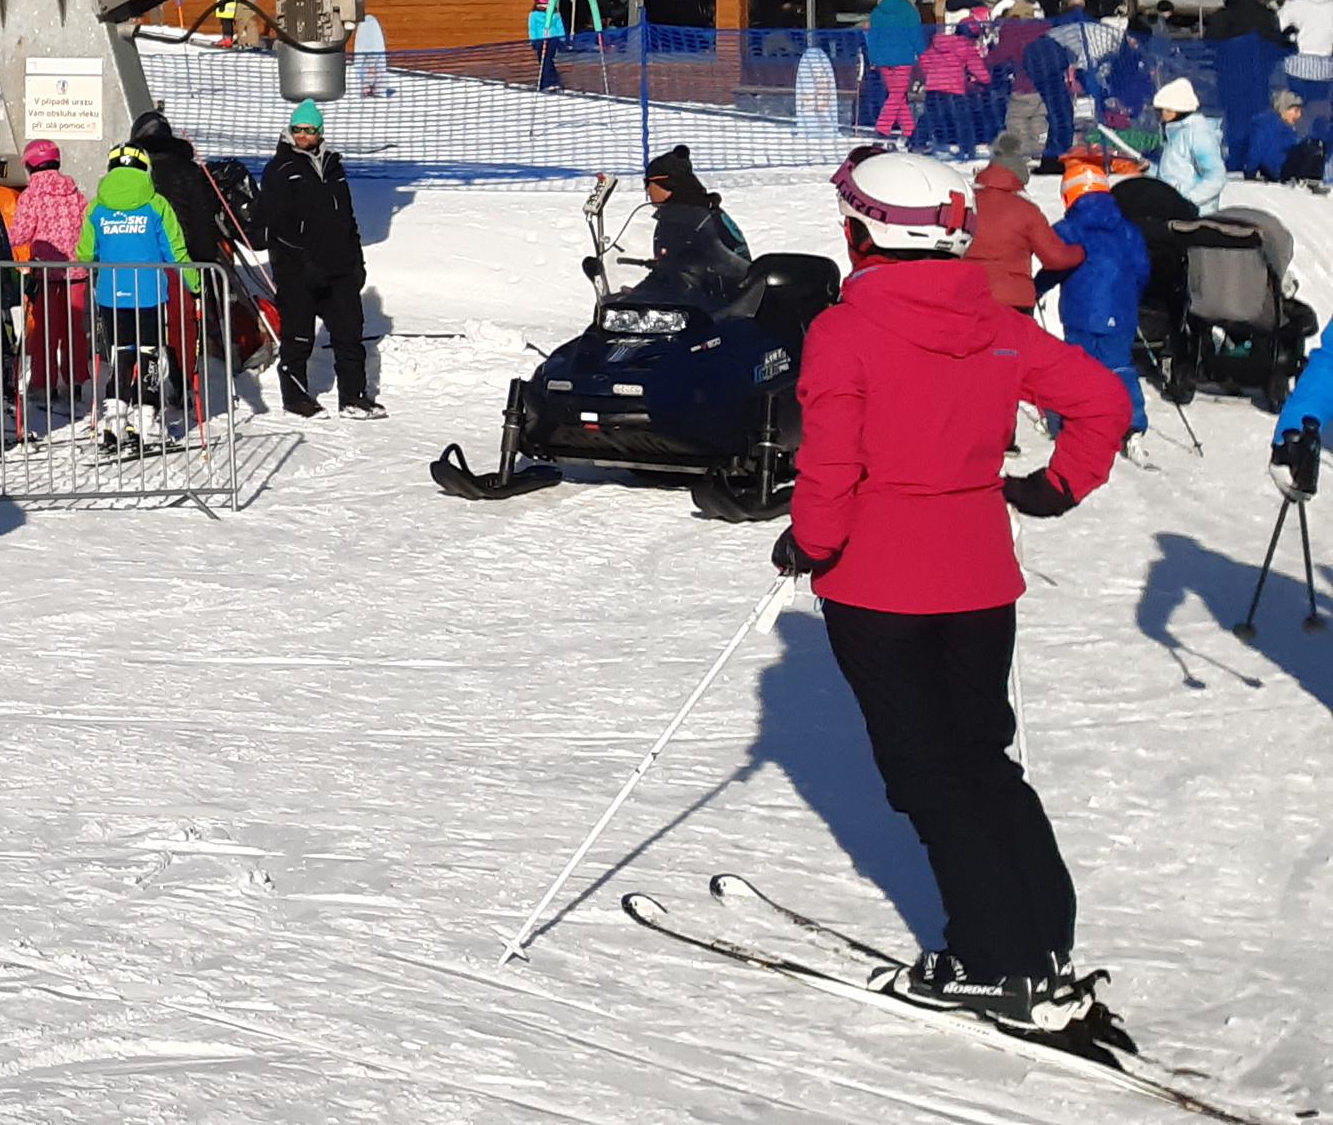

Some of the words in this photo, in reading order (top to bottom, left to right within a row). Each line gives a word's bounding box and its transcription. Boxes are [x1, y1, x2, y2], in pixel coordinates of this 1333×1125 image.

[46, 109, 77, 117] obsluha
[126, 215, 149, 225] SKI
[103, 224, 147, 235] RACING
[942, 980, 1003, 996] NORDICA
